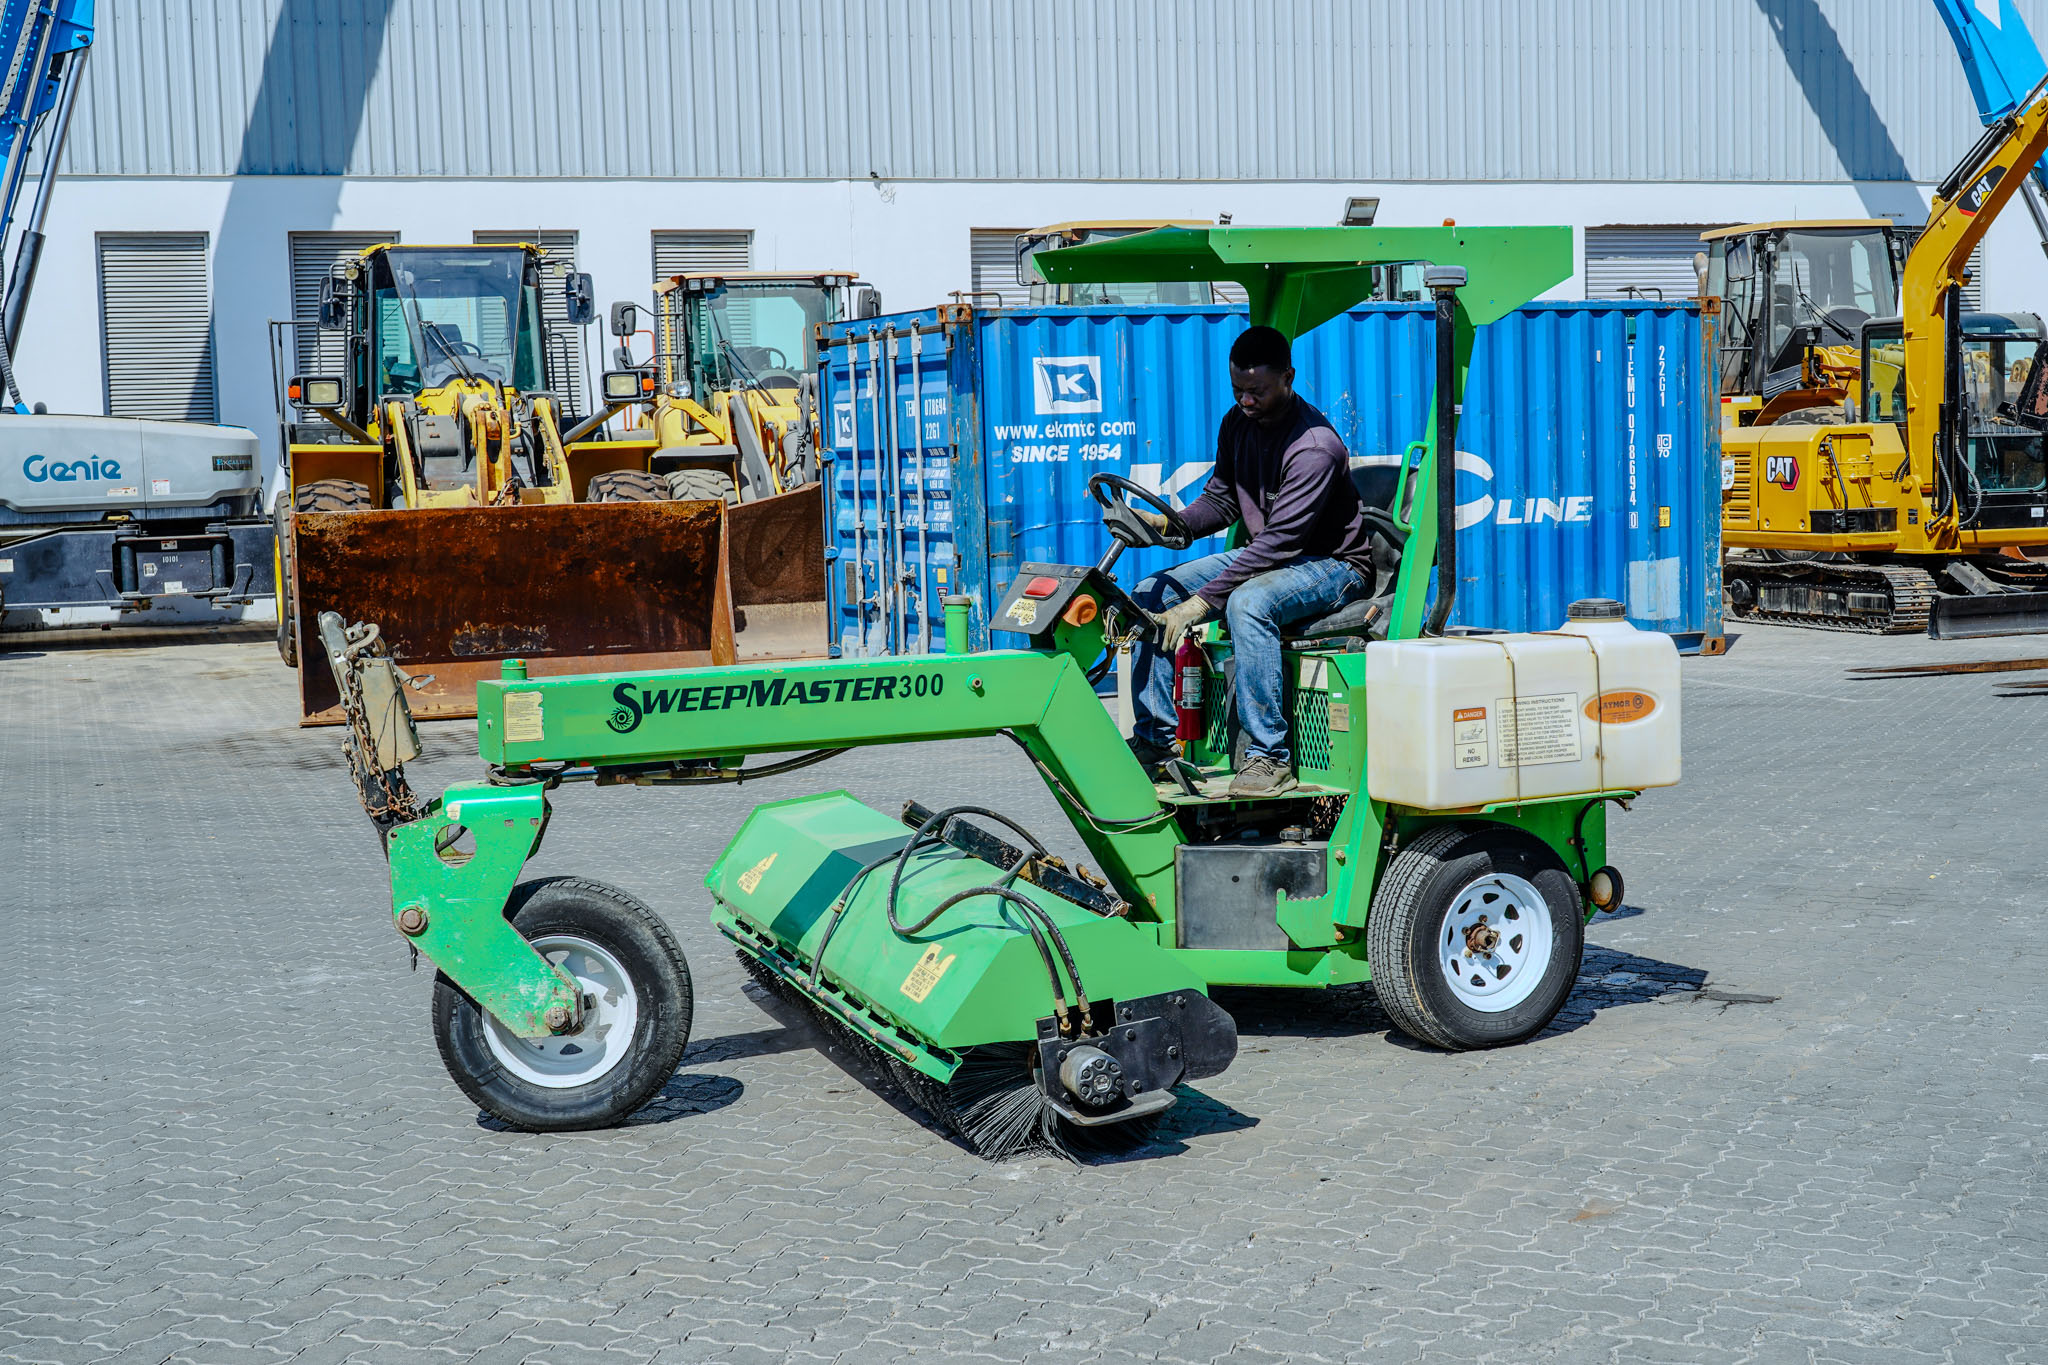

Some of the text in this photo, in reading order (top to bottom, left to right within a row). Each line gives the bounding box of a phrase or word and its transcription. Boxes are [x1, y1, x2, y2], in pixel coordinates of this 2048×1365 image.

[1971, 175, 1992, 207] CAT
[1056, 373, 1088, 395] K
[1627, 346, 1635, 408] TEMU
[841, 416, 851, 433] K
[1011, 443, 1122, 463] SINCE 1954
[1628, 414, 1637, 506] 078694
[23, 454, 122, 482] Genie
[1766, 456, 1793, 482] CAT
[1496, 495, 1594, 526] LINE
[1599, 699, 1630, 709] AYMOR
